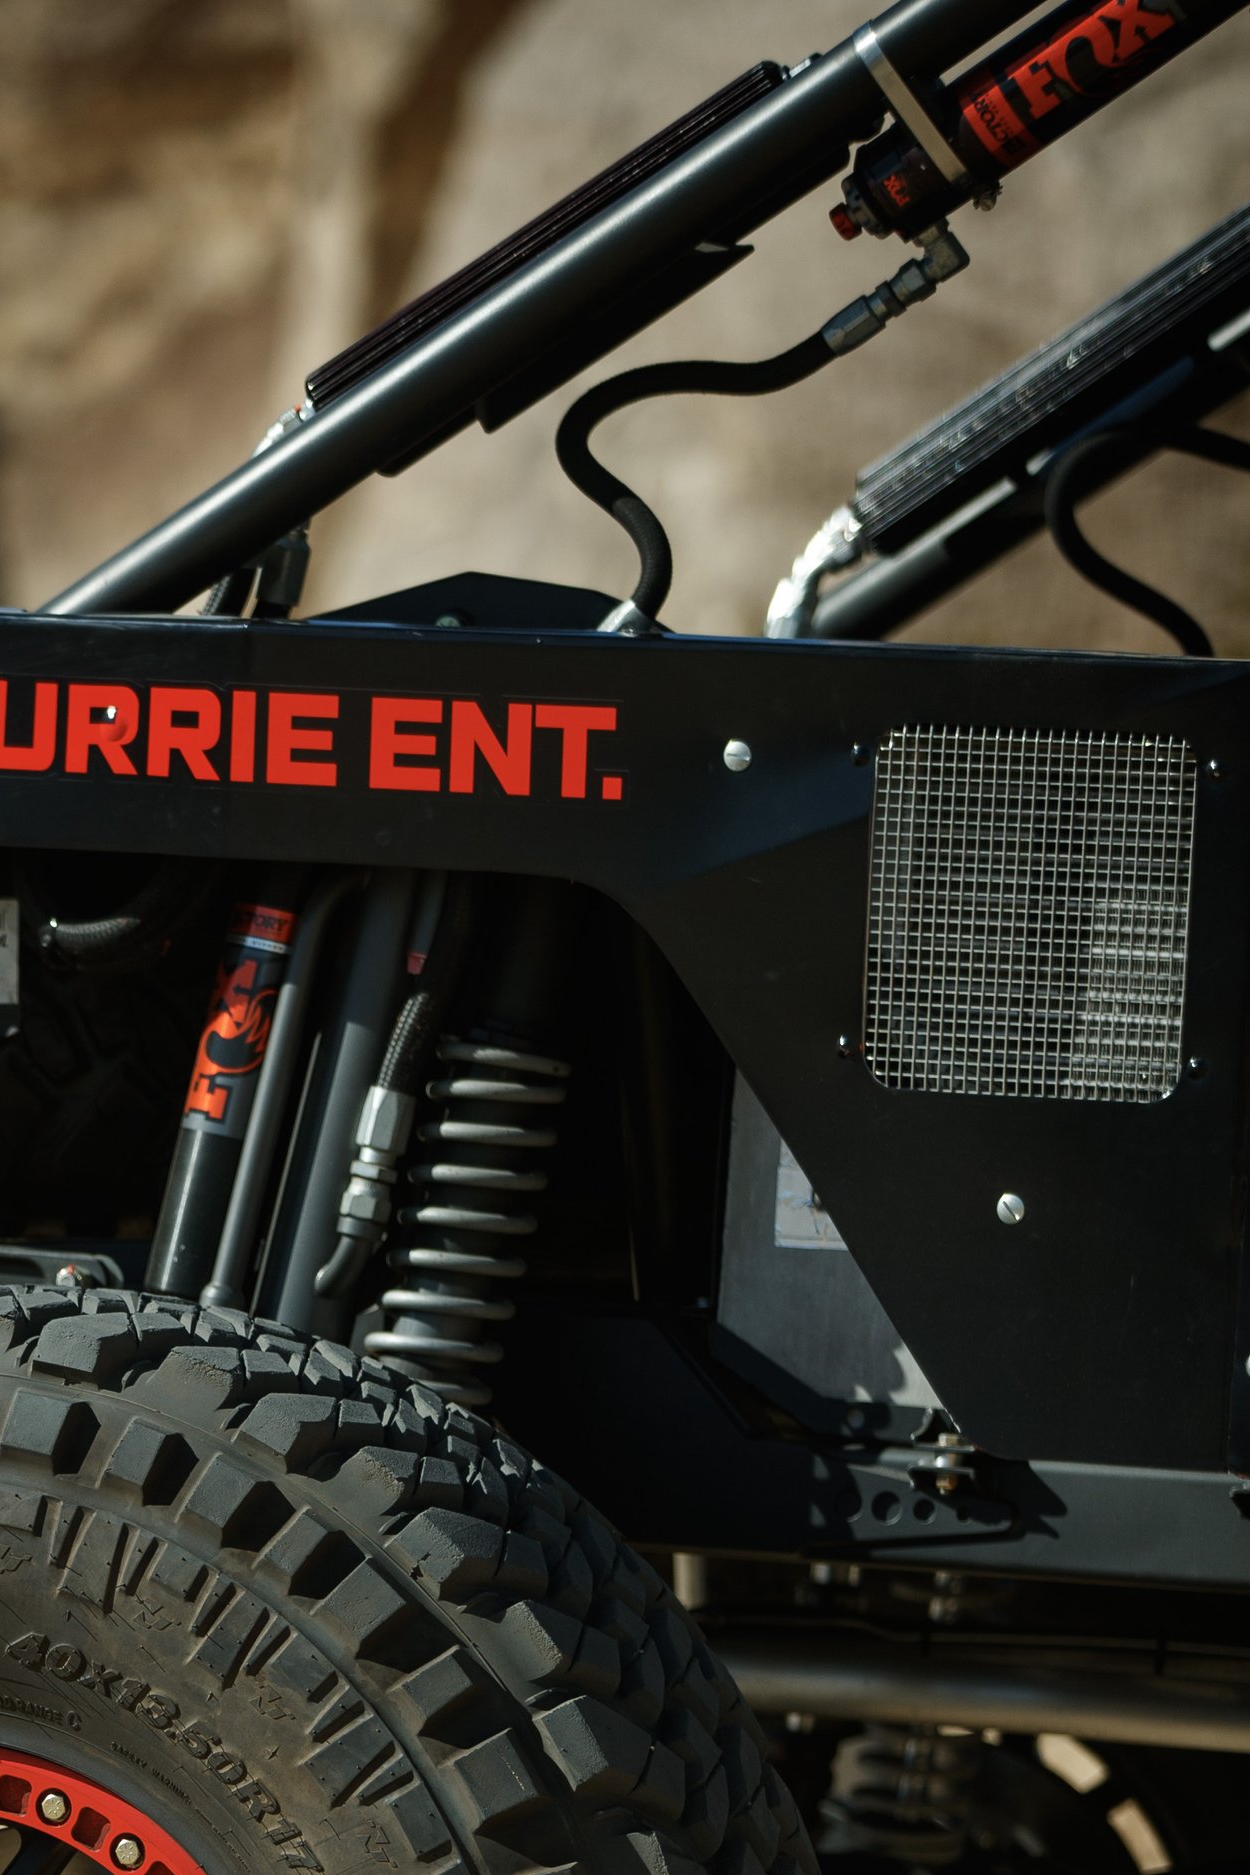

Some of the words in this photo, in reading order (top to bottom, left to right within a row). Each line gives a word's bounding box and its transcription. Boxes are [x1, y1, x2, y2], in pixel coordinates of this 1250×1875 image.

[1010, 0, 1178, 121] FOX
[883, 174, 912, 208] FOX
[369, 696, 623, 800] ENT.
